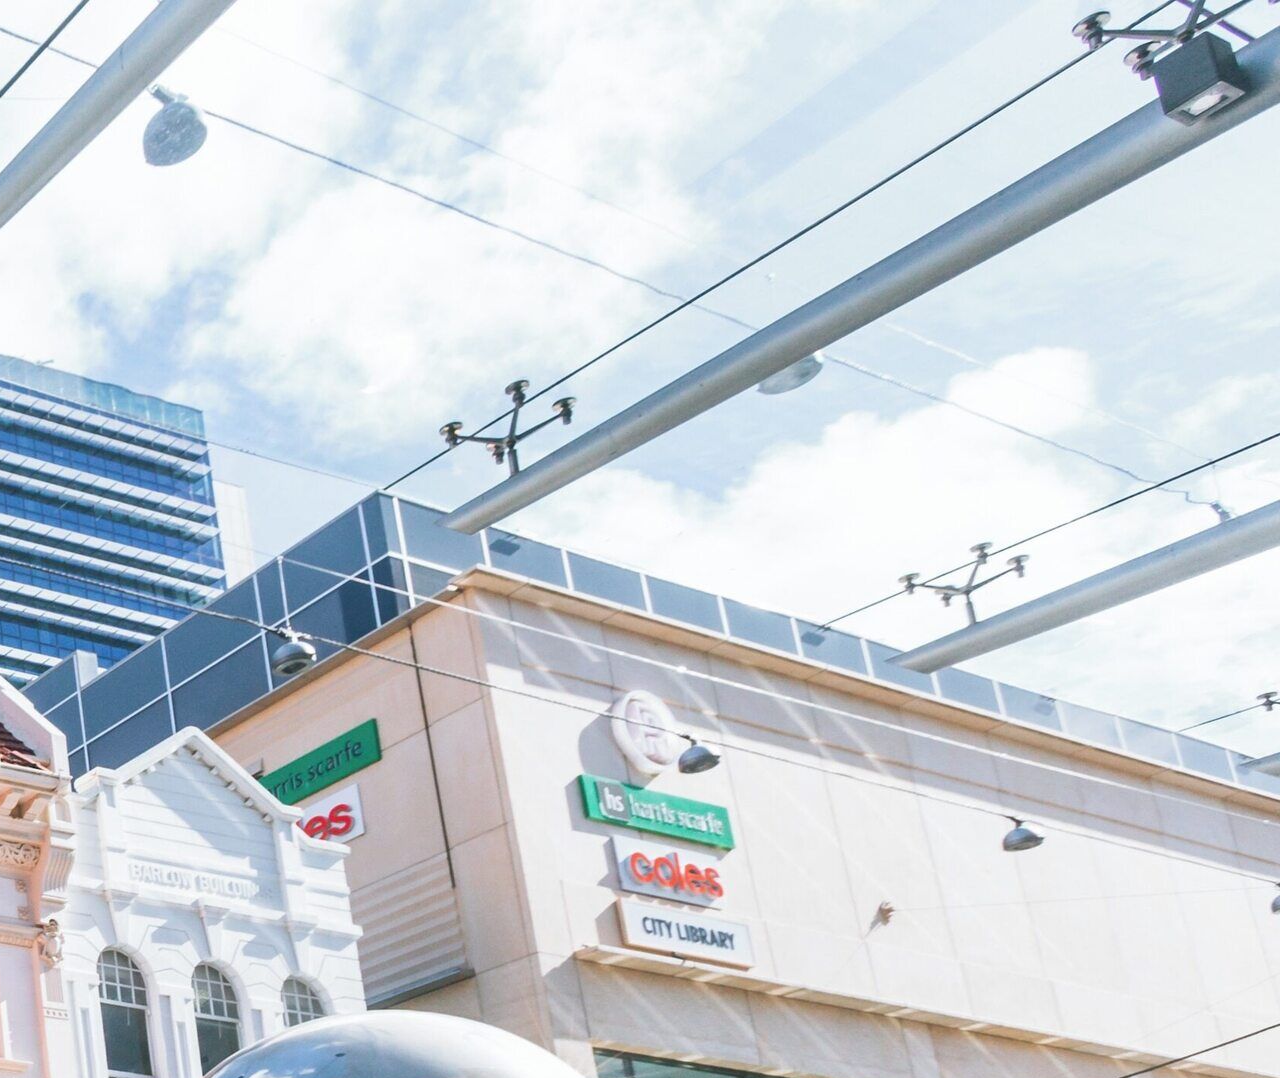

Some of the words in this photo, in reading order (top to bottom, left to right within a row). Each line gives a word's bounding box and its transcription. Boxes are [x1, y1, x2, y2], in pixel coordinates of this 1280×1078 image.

[308, 740, 363, 782] scarfe
[630, 852, 724, 899] coles
[643, 916, 674, 941] CITY
[676, 922, 736, 951] LIBRARY
